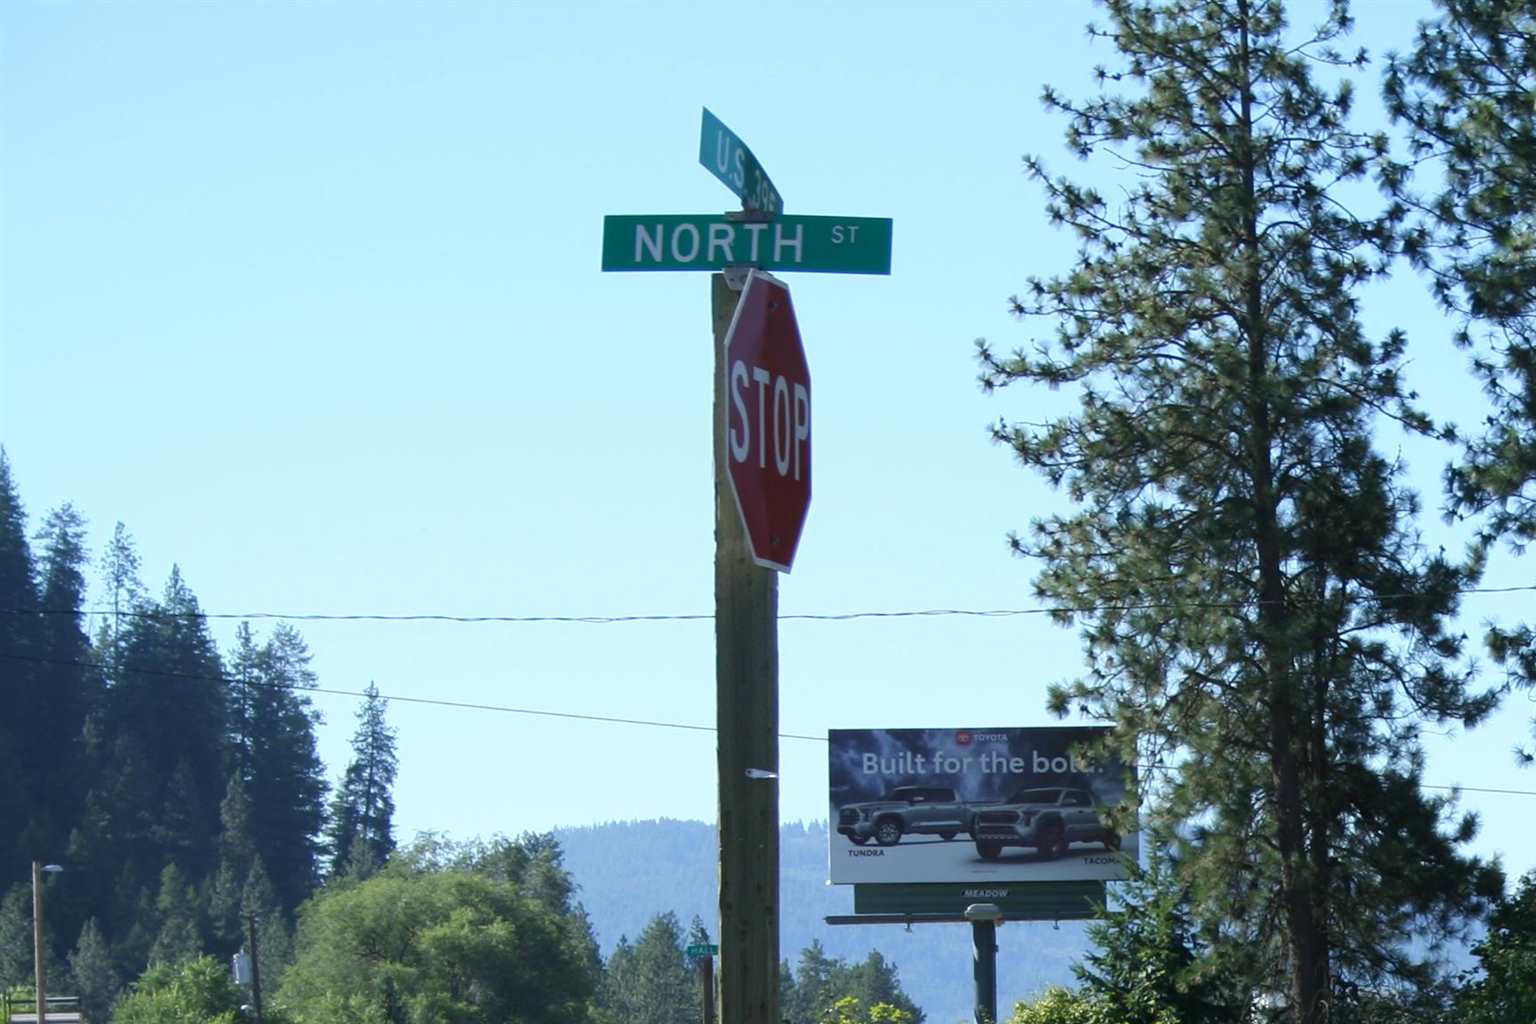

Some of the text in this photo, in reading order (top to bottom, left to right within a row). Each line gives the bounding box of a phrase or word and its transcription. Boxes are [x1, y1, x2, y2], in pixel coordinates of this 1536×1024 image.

[633, 223, 859, 263] NORTH ST
[730, 359, 810, 481] STOP
[973, 734, 1008, 742] TOYOTA
[862, 752, 926, 775] Built
[932, 752, 970, 774] for
[978, 751, 1025, 774] the
[847, 849, 885, 857] TUNDRA
[963, 887, 1008, 897] MEADOW
